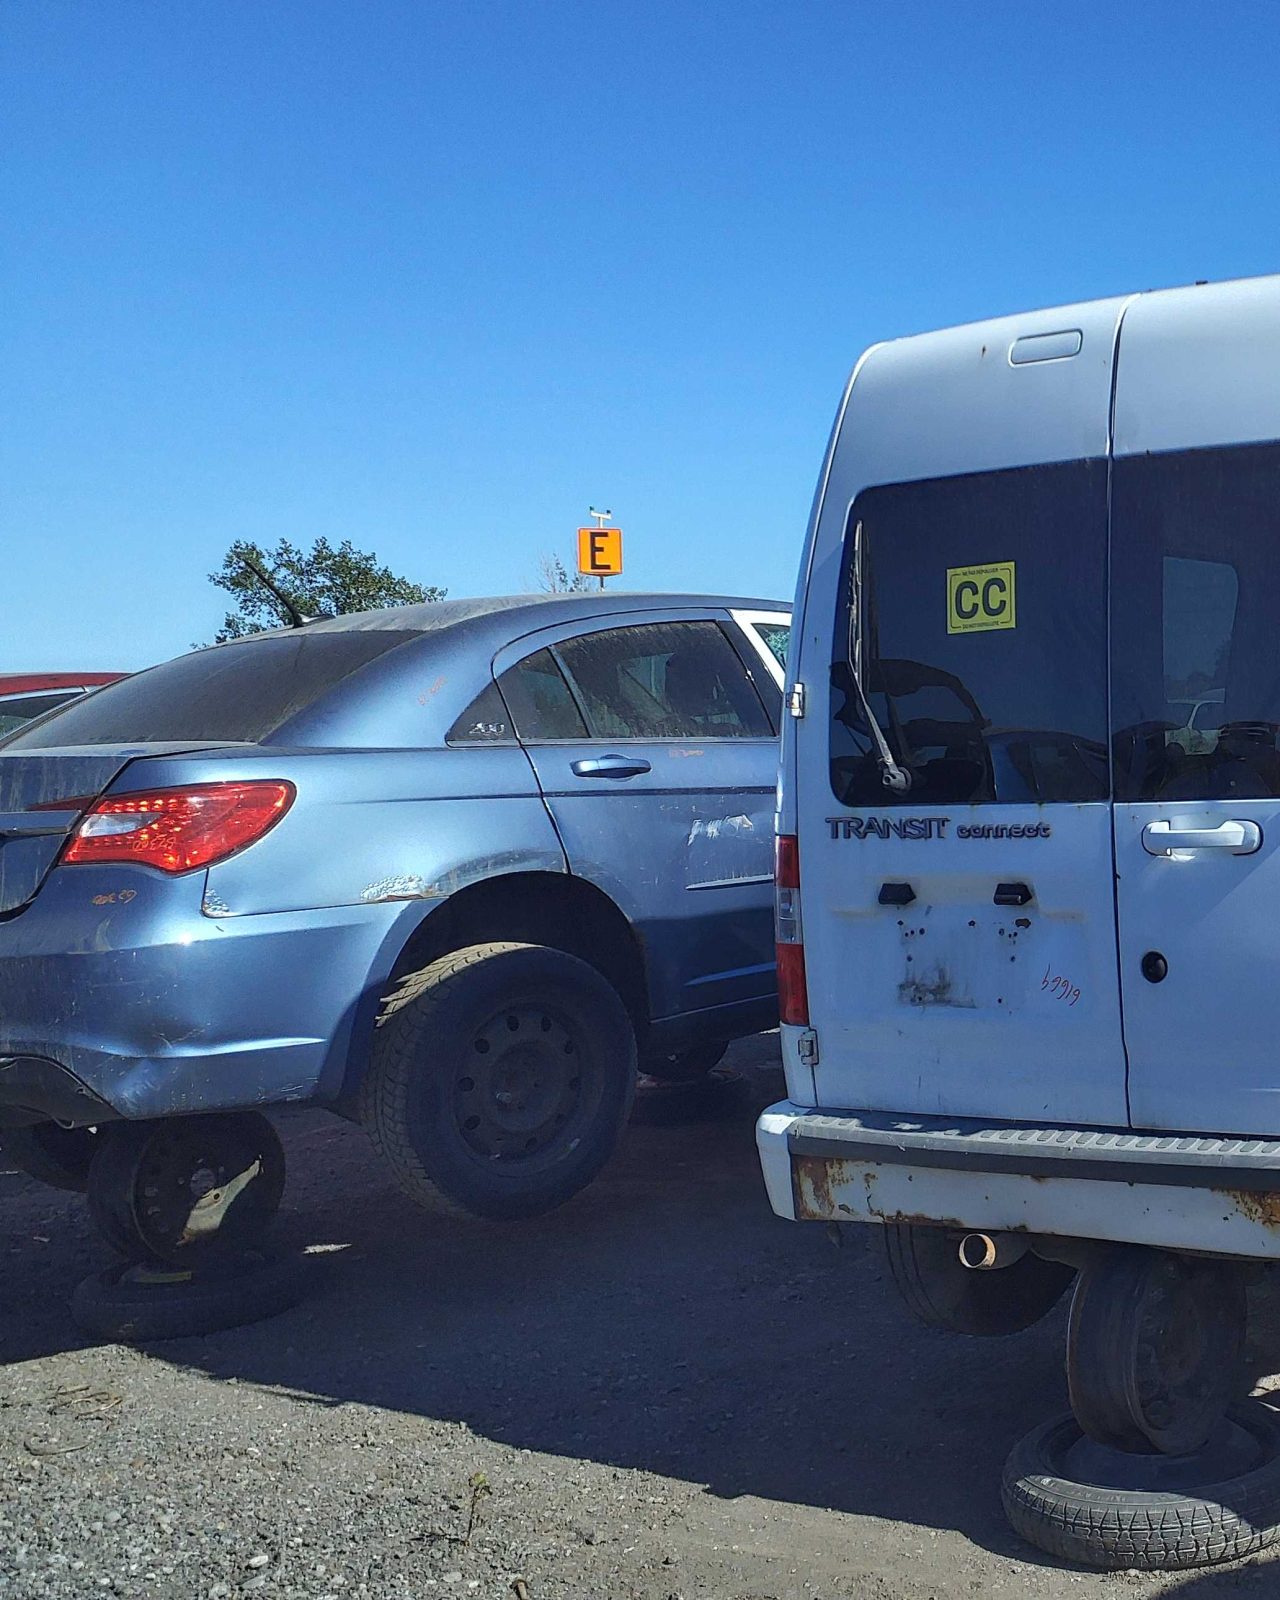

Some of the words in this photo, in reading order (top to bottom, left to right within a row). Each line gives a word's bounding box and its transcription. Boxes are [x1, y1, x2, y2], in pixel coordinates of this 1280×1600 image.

[590, 532, 611, 570] E
[955, 577, 1007, 619] CC
[825, 817, 950, 839] TRANSIT
[957, 822, 1050, 839] connect
